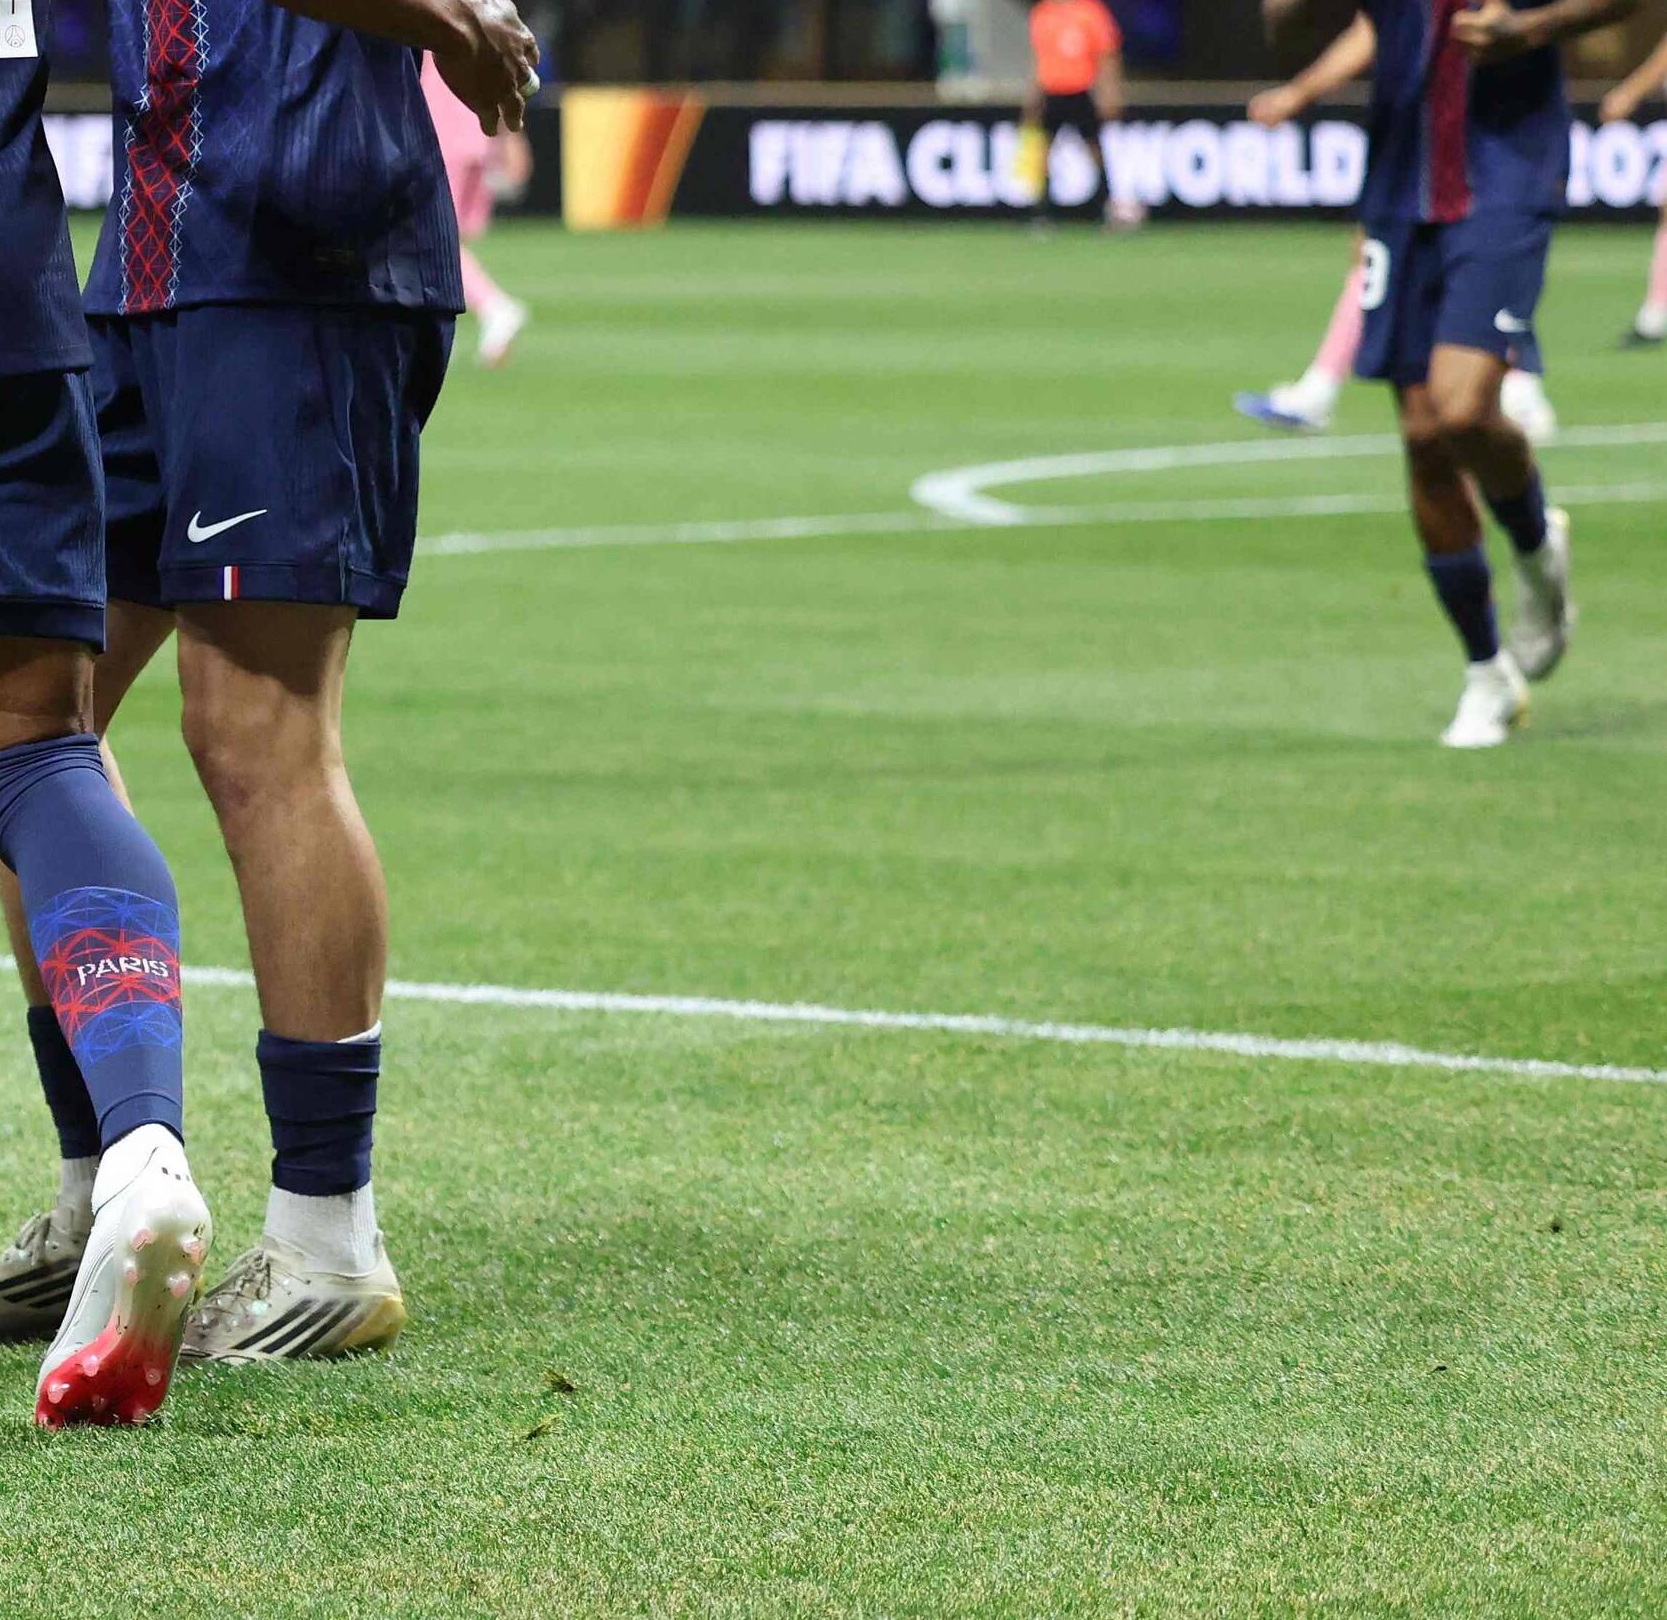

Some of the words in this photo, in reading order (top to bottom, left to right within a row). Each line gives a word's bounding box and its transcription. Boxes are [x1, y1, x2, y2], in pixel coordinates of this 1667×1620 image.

[749, 121, 906, 206] FIFA
[1099, 120, 1367, 206] WORLD
[76, 955, 170, 986] PARIS
